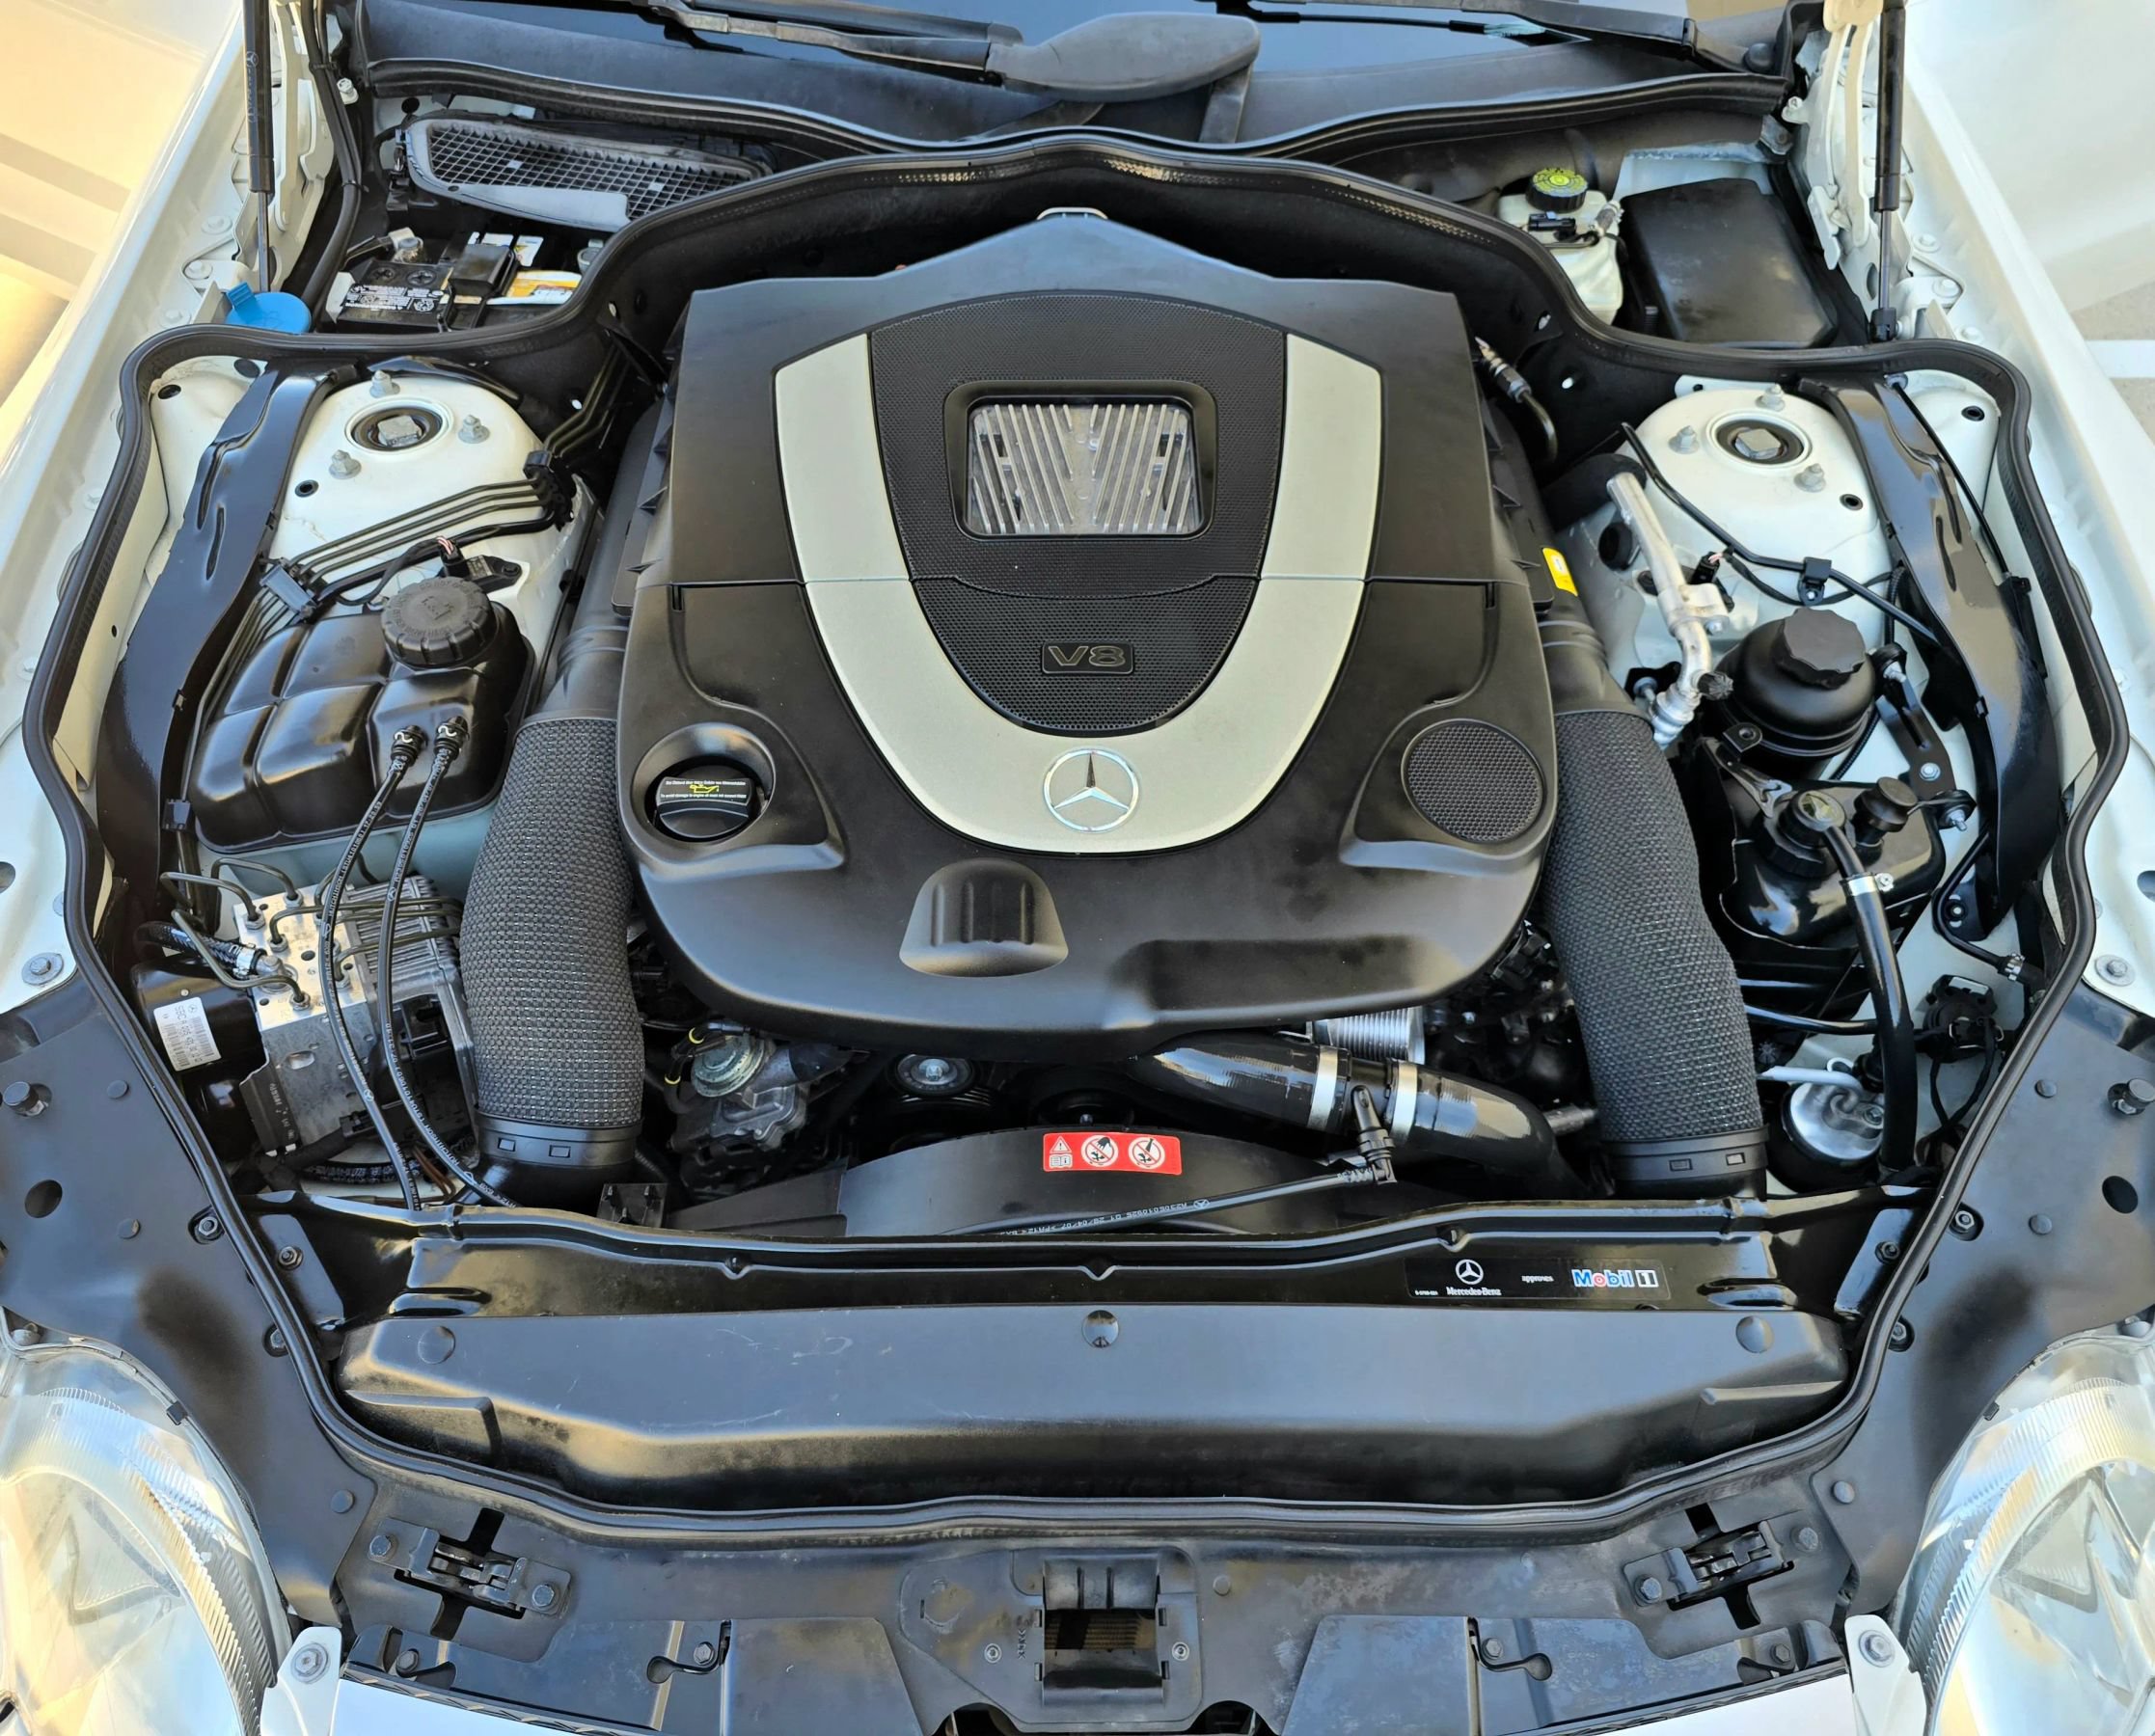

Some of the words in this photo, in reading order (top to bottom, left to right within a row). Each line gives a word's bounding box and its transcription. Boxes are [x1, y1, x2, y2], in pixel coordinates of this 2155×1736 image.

[1048, 645, 1127, 667] V8
[175, 1005, 187, 1020] SBC
[1571, 1268, 1636, 1288] Mobil
[1446, 1286, 1502, 1297] Mercedes-Benz
